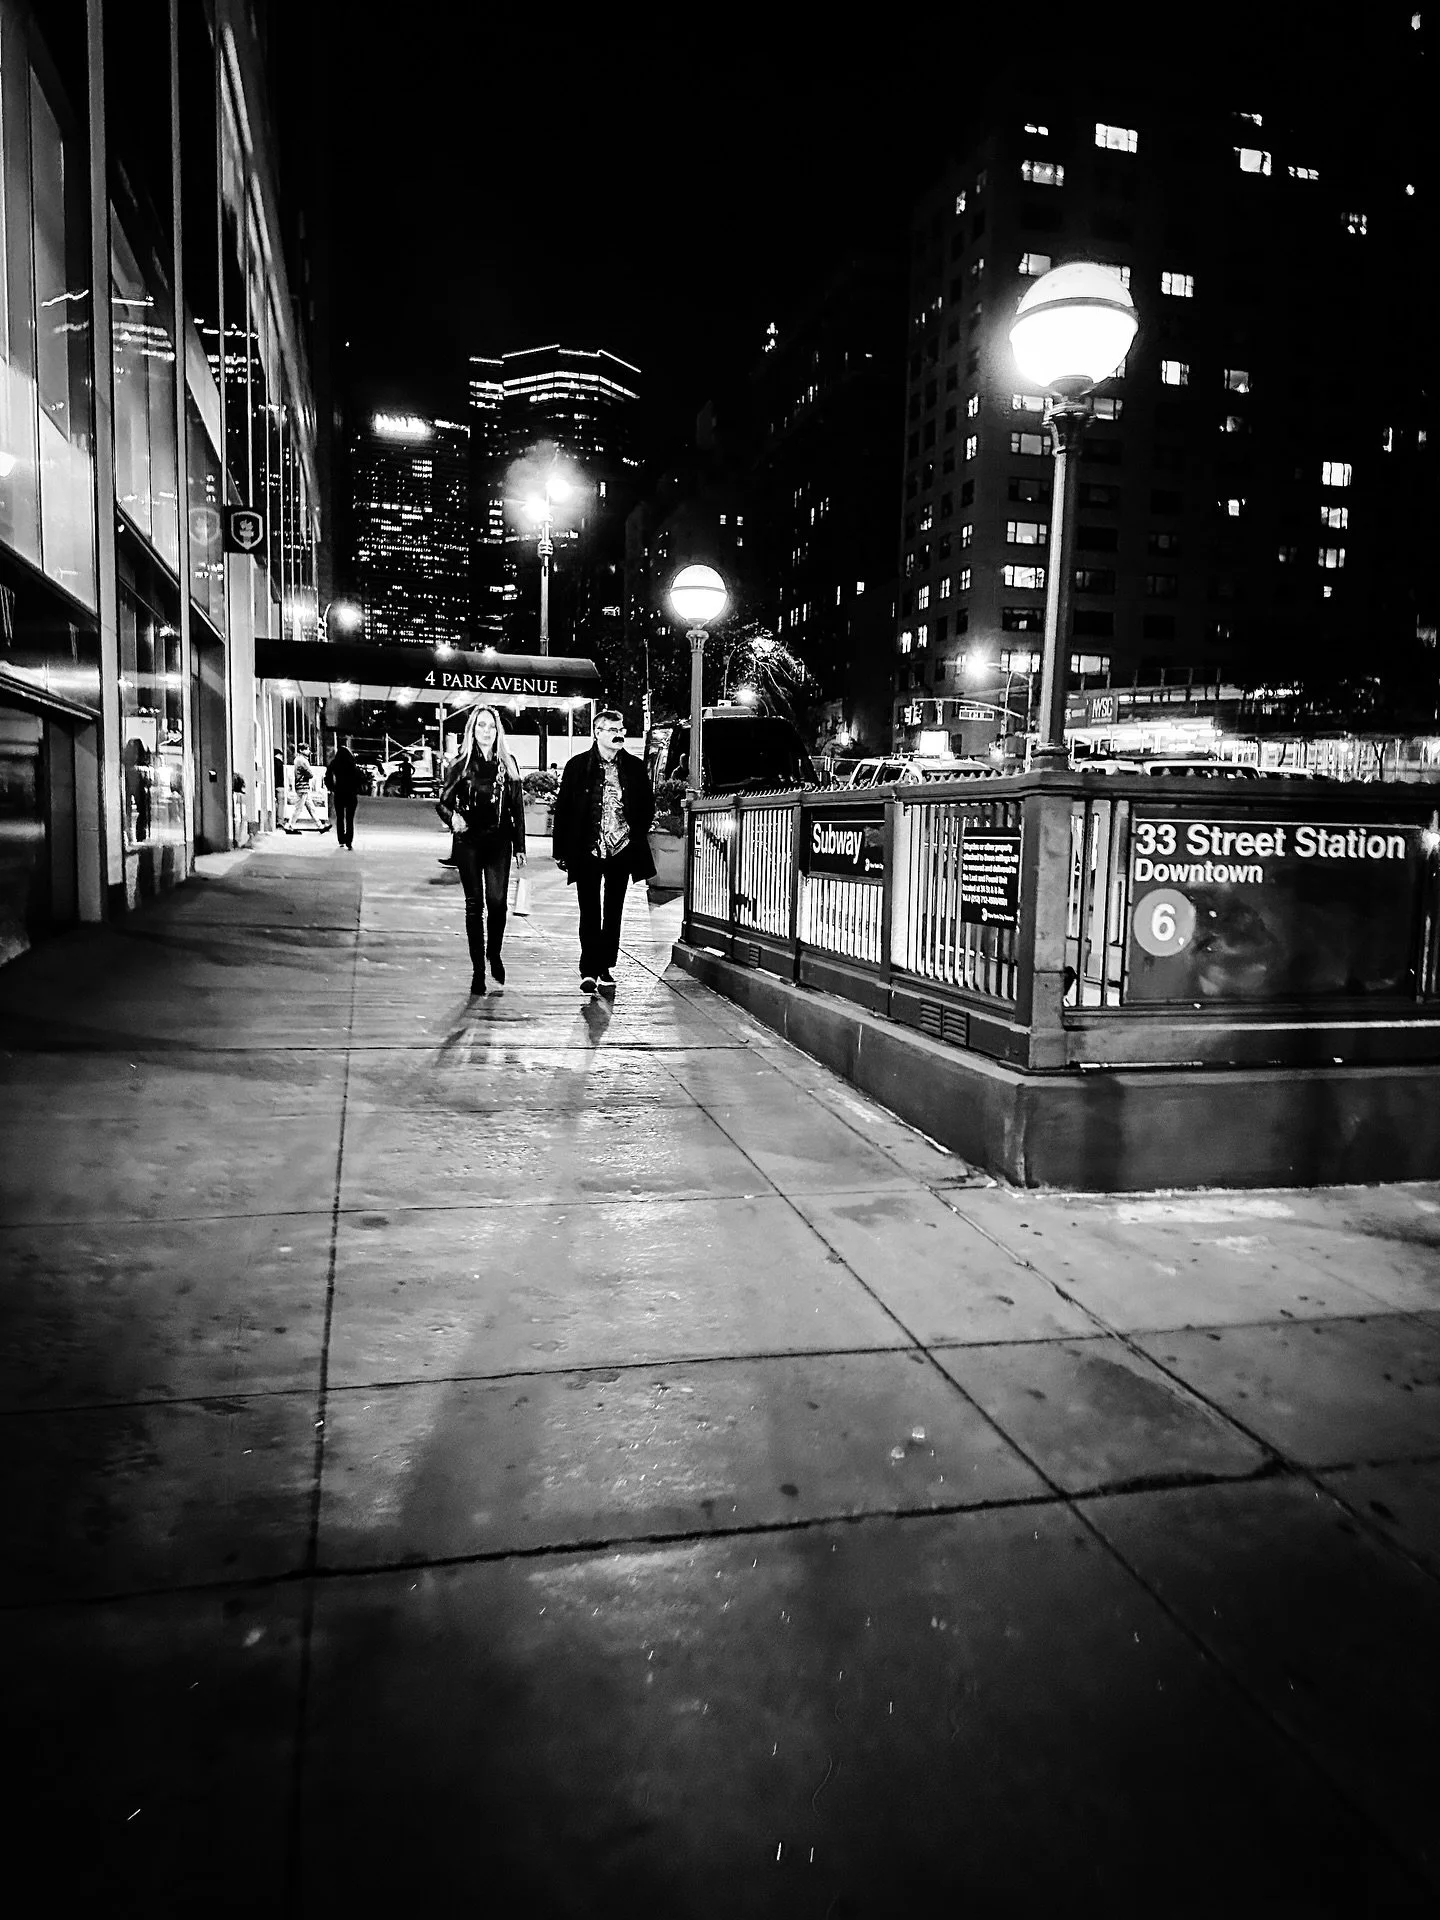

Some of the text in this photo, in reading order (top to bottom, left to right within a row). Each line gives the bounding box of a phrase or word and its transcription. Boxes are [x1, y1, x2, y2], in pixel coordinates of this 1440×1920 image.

[425, 671, 558, 694] 4 PARK AVENUE
[812, 823, 863, 865] Subway
[1135, 823, 1406, 860] 33 Street Station
[1134, 858, 1264, 884] Downtown
[1151, 903, 1177, 942] 6
